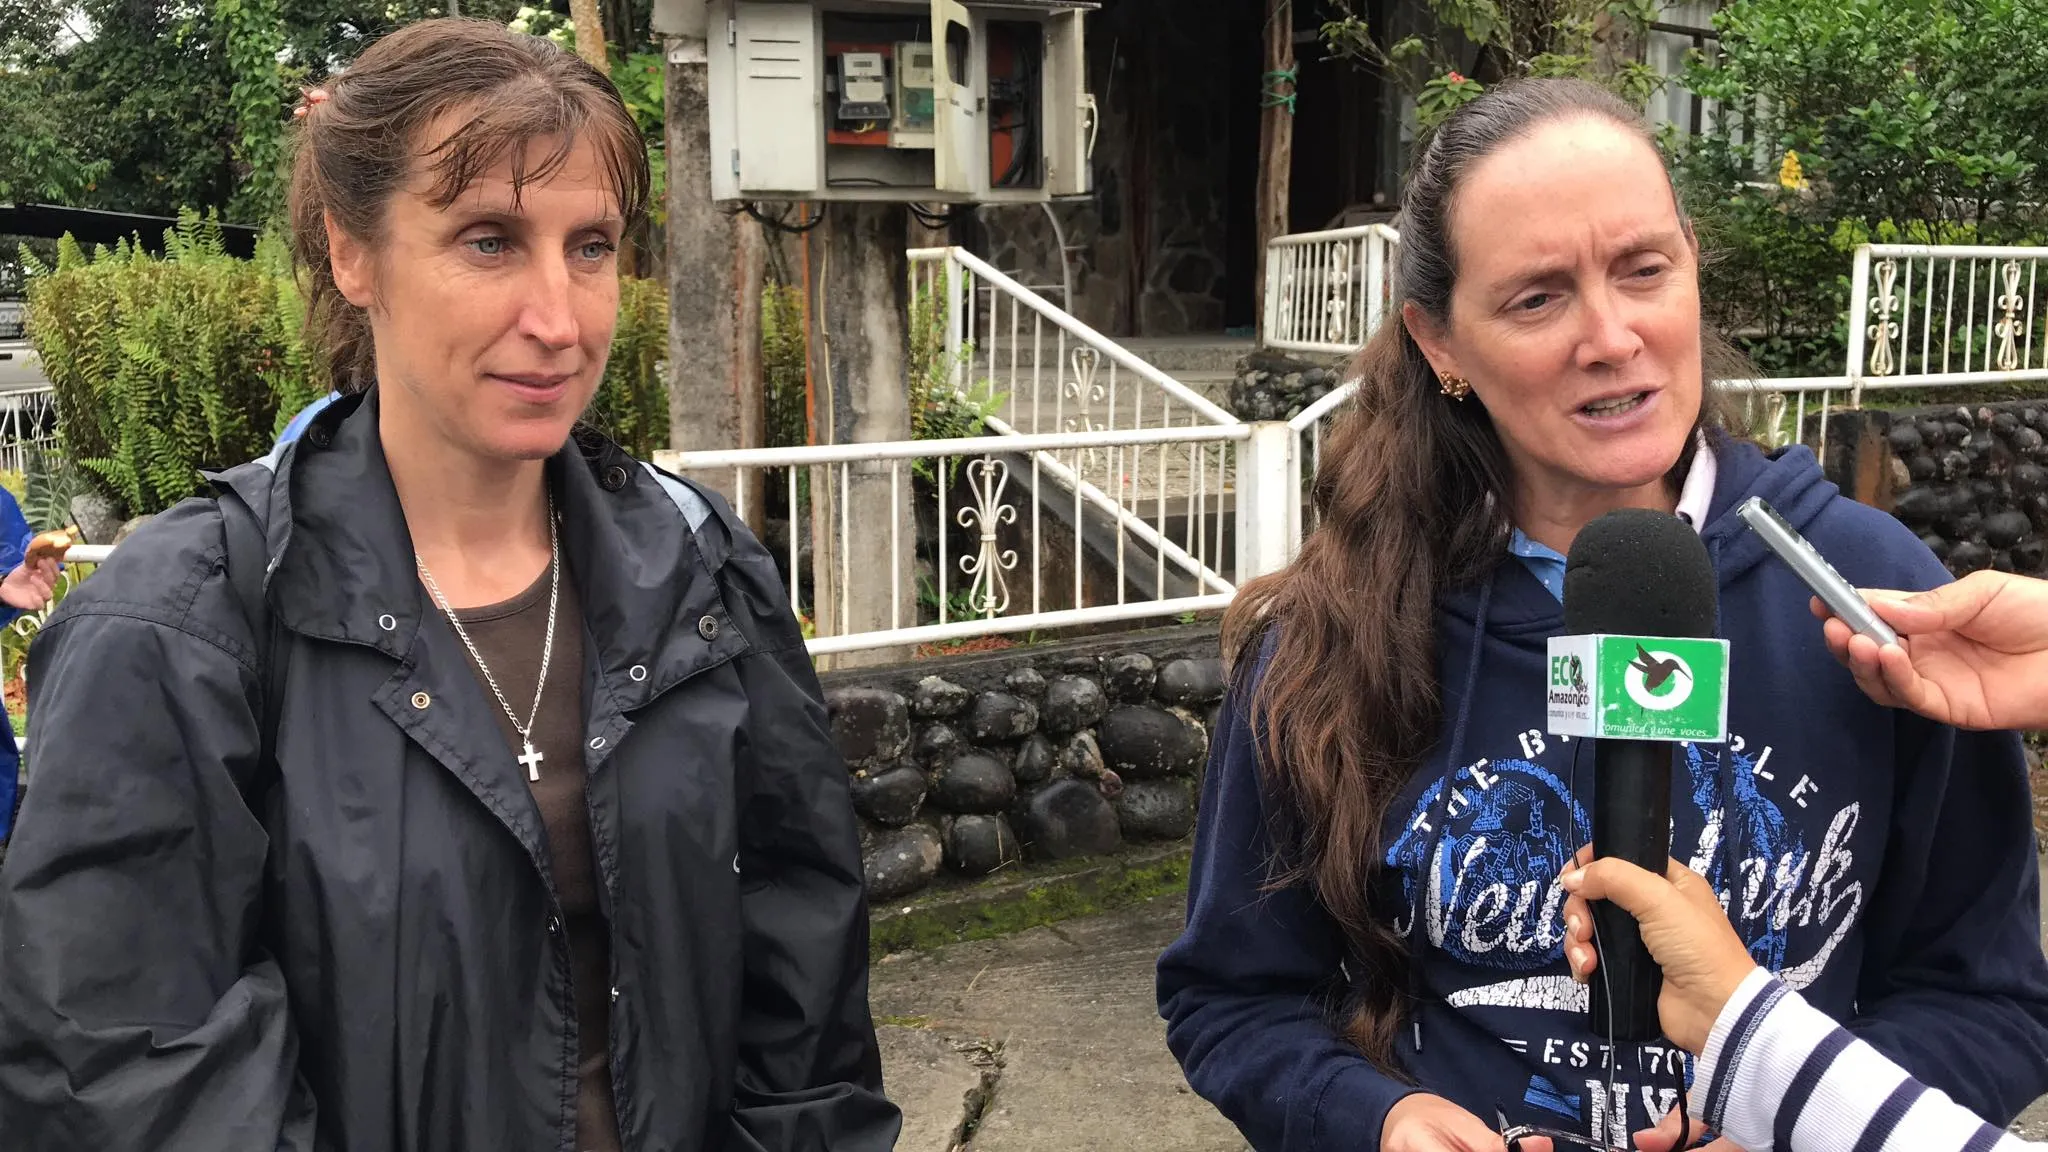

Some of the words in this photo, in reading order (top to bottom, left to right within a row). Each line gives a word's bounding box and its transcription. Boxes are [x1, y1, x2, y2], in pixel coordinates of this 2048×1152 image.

[1551, 655, 1583, 686] ECO
[1656, 727, 1676, 736] une
[1412, 757, 1500, 833] THE
[1543, 1038, 1622, 1069] EST.
